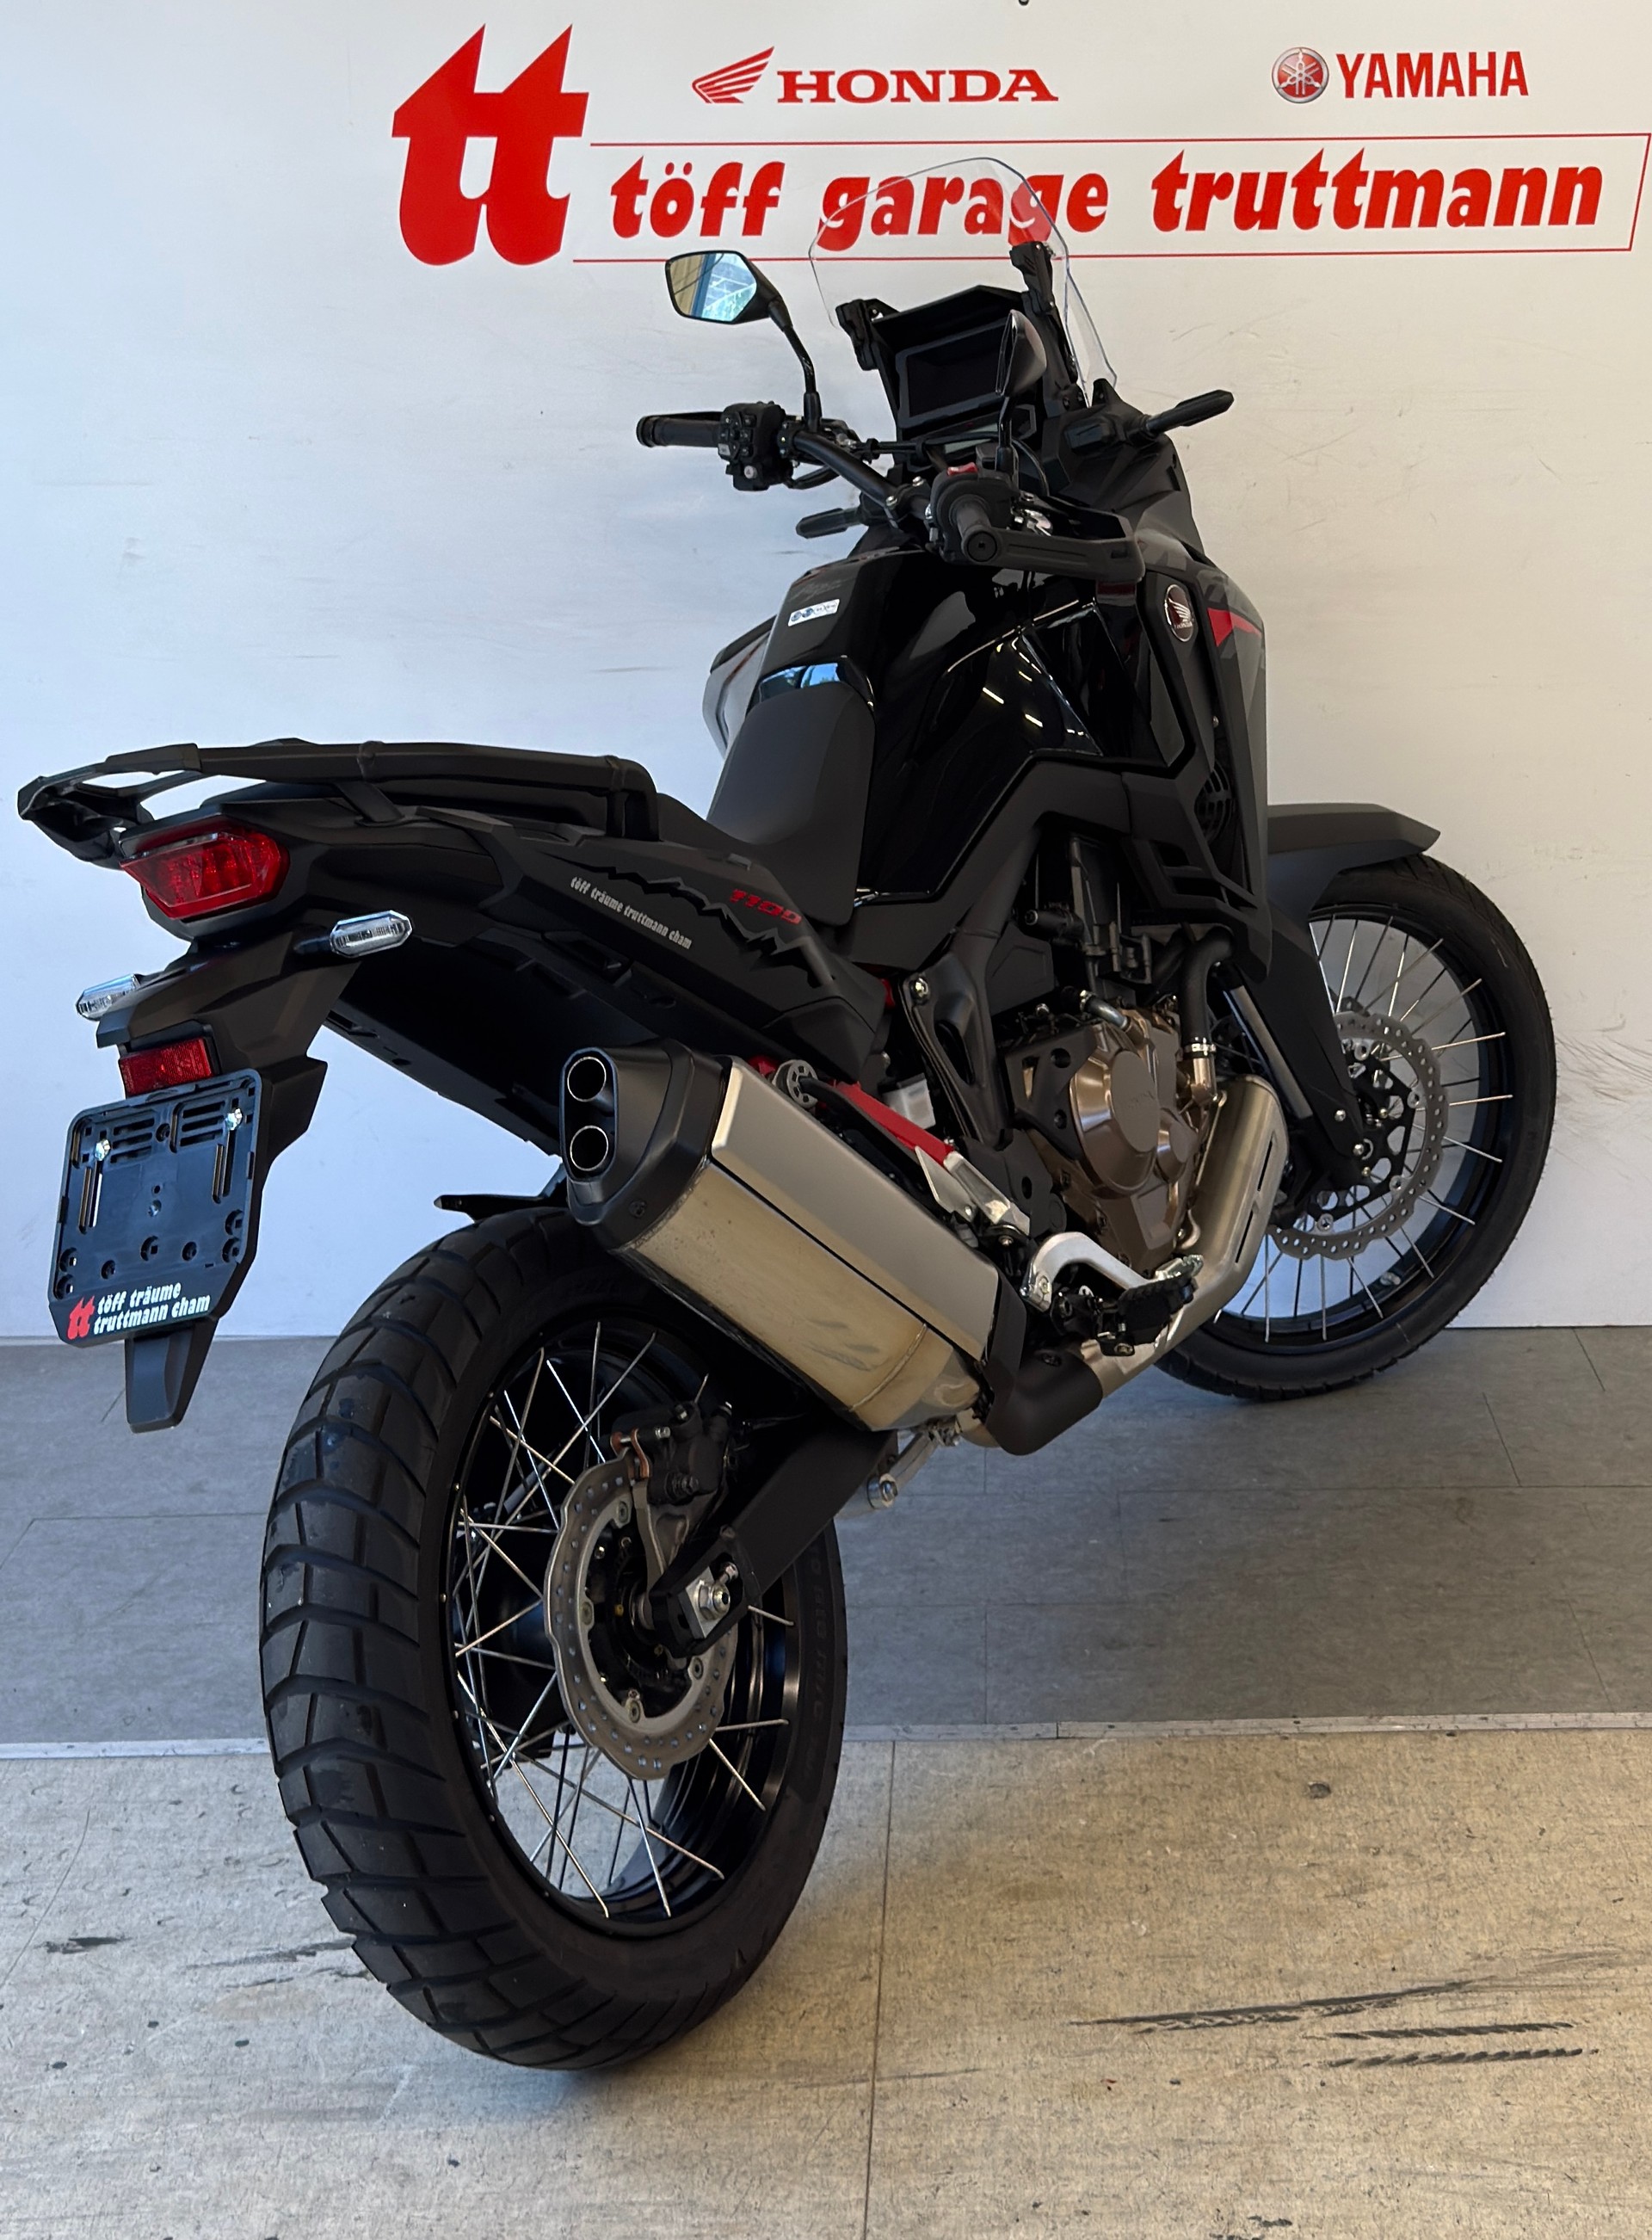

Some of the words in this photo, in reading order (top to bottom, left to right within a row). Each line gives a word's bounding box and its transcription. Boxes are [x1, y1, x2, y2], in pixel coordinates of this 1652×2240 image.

[777, 68, 1059, 103] HONDA
[1335, 51, 1529, 99] YAMAHA
[391, 23, 589, 266] tt
[610, 156, 786, 238] töff
[817, 173, 1108, 251] garage
[1150, 148, 1603, 233] truttmann
[570, 876, 592, 895] töff
[590, 886, 624, 913] träume
[623, 904, 669, 938] truttmann
[668, 929, 693, 950] cham
[93, 1303, 169, 1335] truttmann
[171, 1294, 211, 1318] cham
[97, 1290, 127, 1315] töff
[129, 1282, 182, 1308] träume
